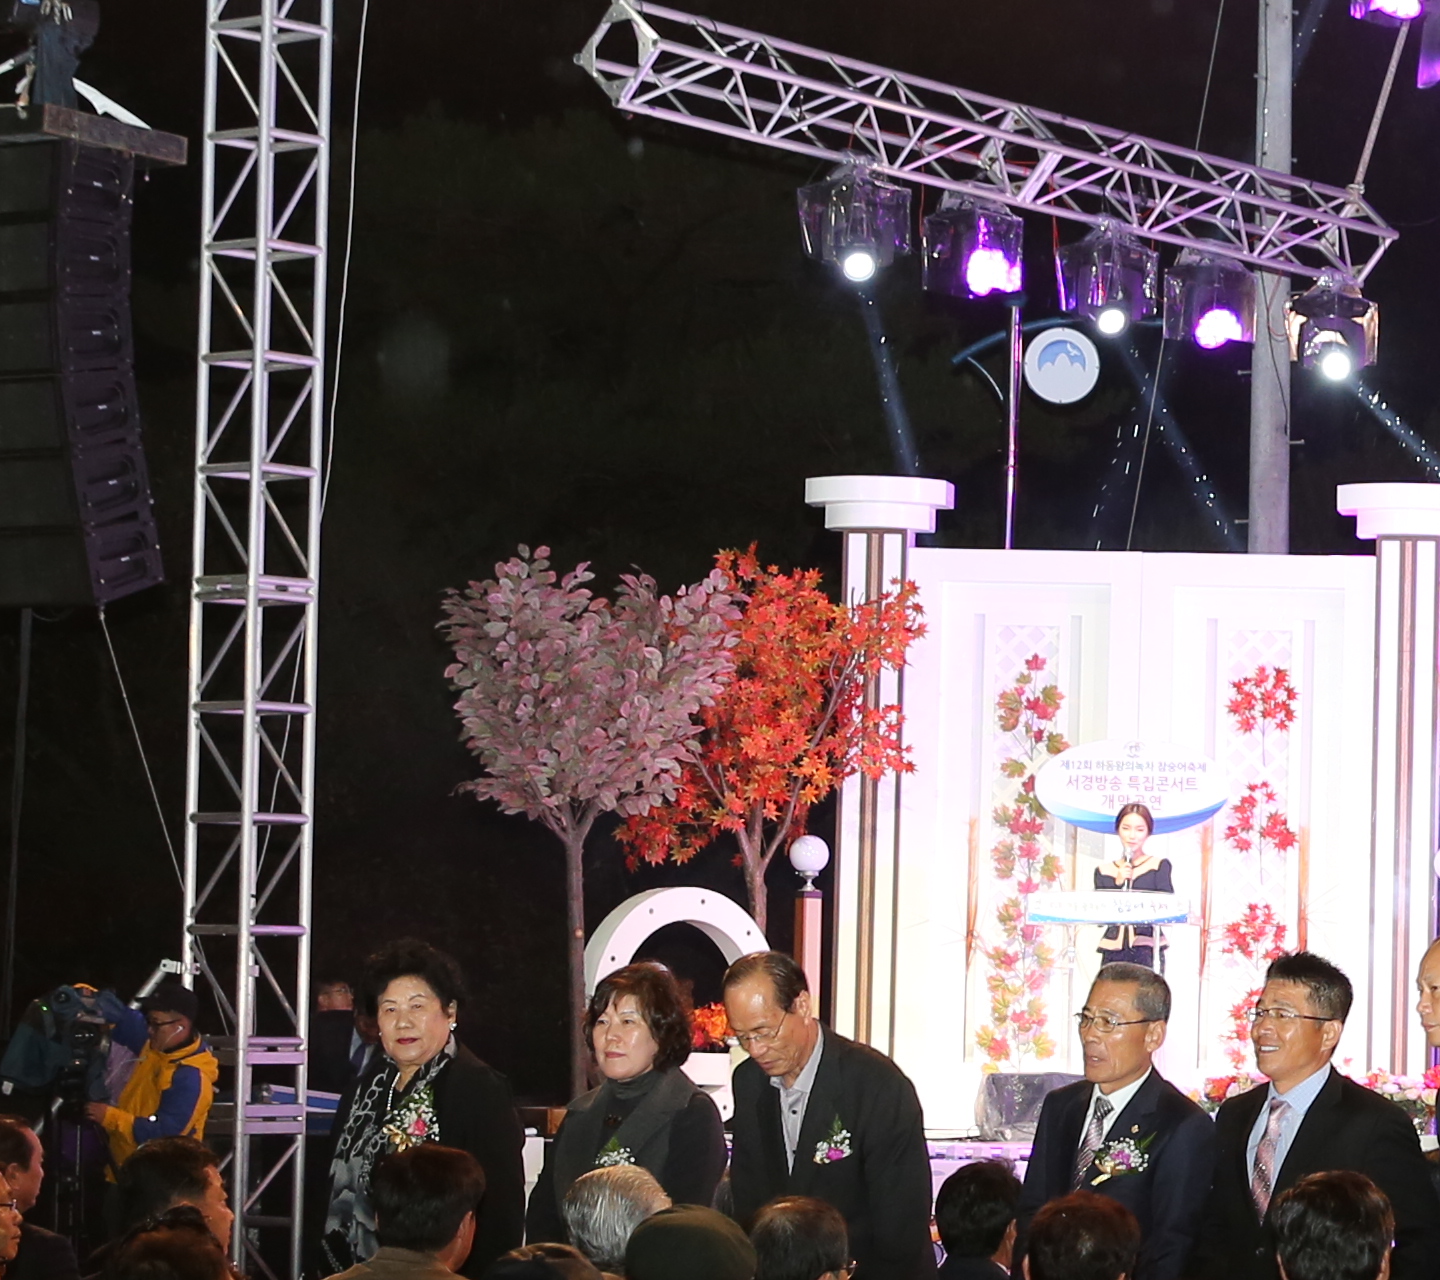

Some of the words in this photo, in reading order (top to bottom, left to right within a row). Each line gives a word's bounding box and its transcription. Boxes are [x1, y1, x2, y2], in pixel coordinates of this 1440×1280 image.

[1060, 759, 1092, 771] 제12회
[1066, 775, 1122, 792] 서경방송
[1127, 775, 1199, 793] 특집콘서트
